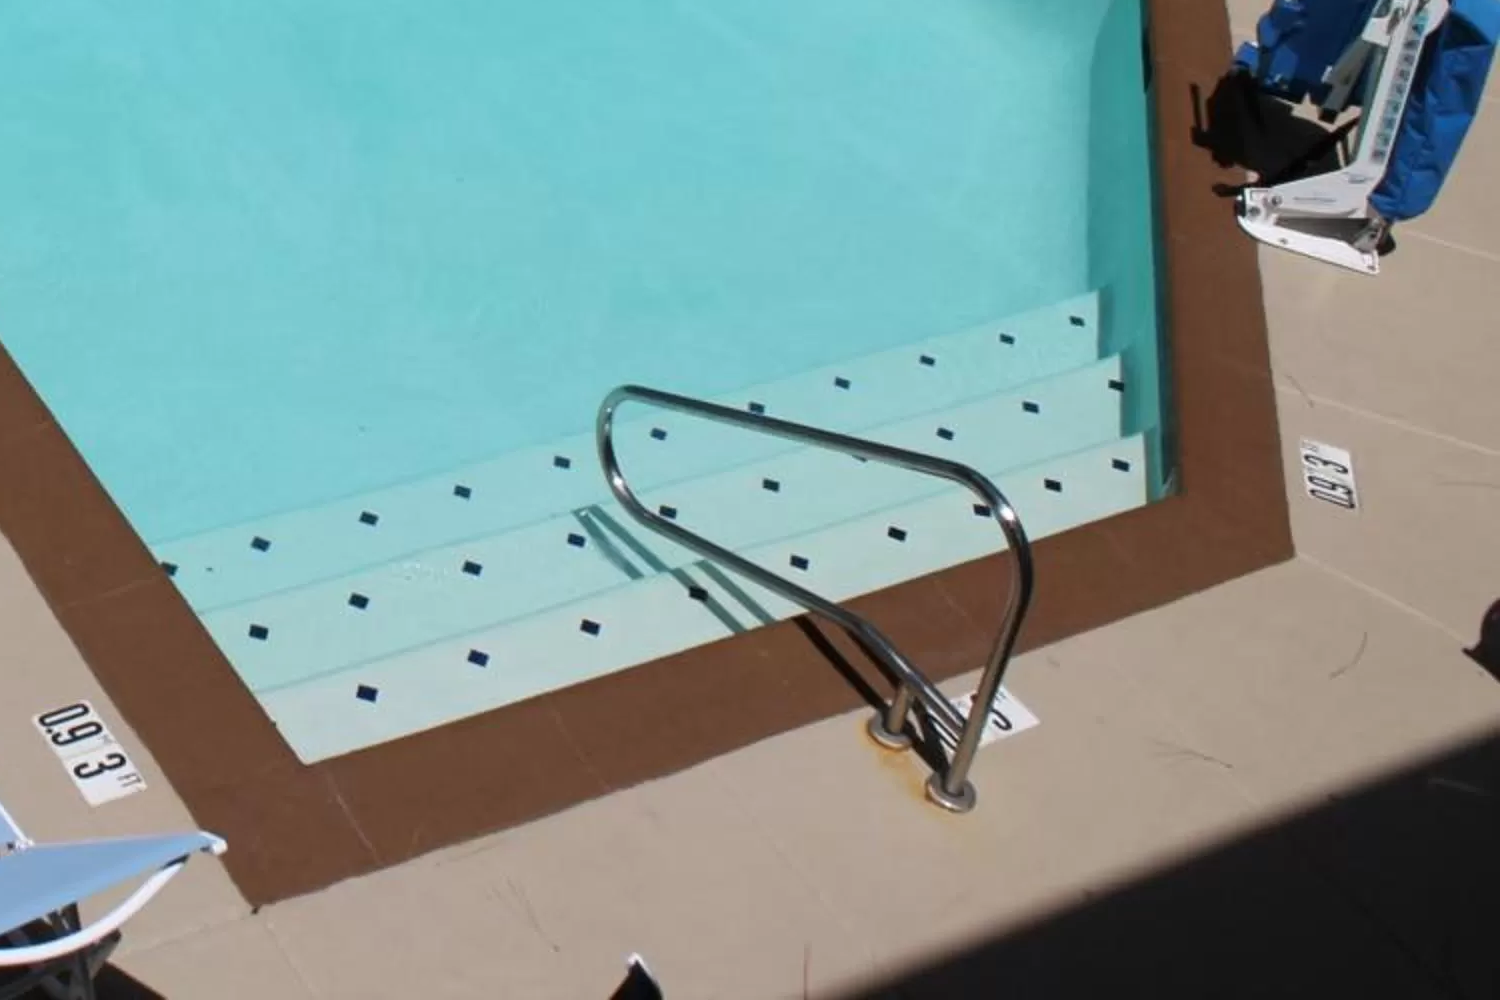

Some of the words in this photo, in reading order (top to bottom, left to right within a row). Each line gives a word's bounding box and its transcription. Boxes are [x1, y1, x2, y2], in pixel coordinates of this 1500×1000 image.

[1303, 453, 1349, 474] 3
[38, 702, 104, 747] 0.9
[73, 752, 127, 780] 3
